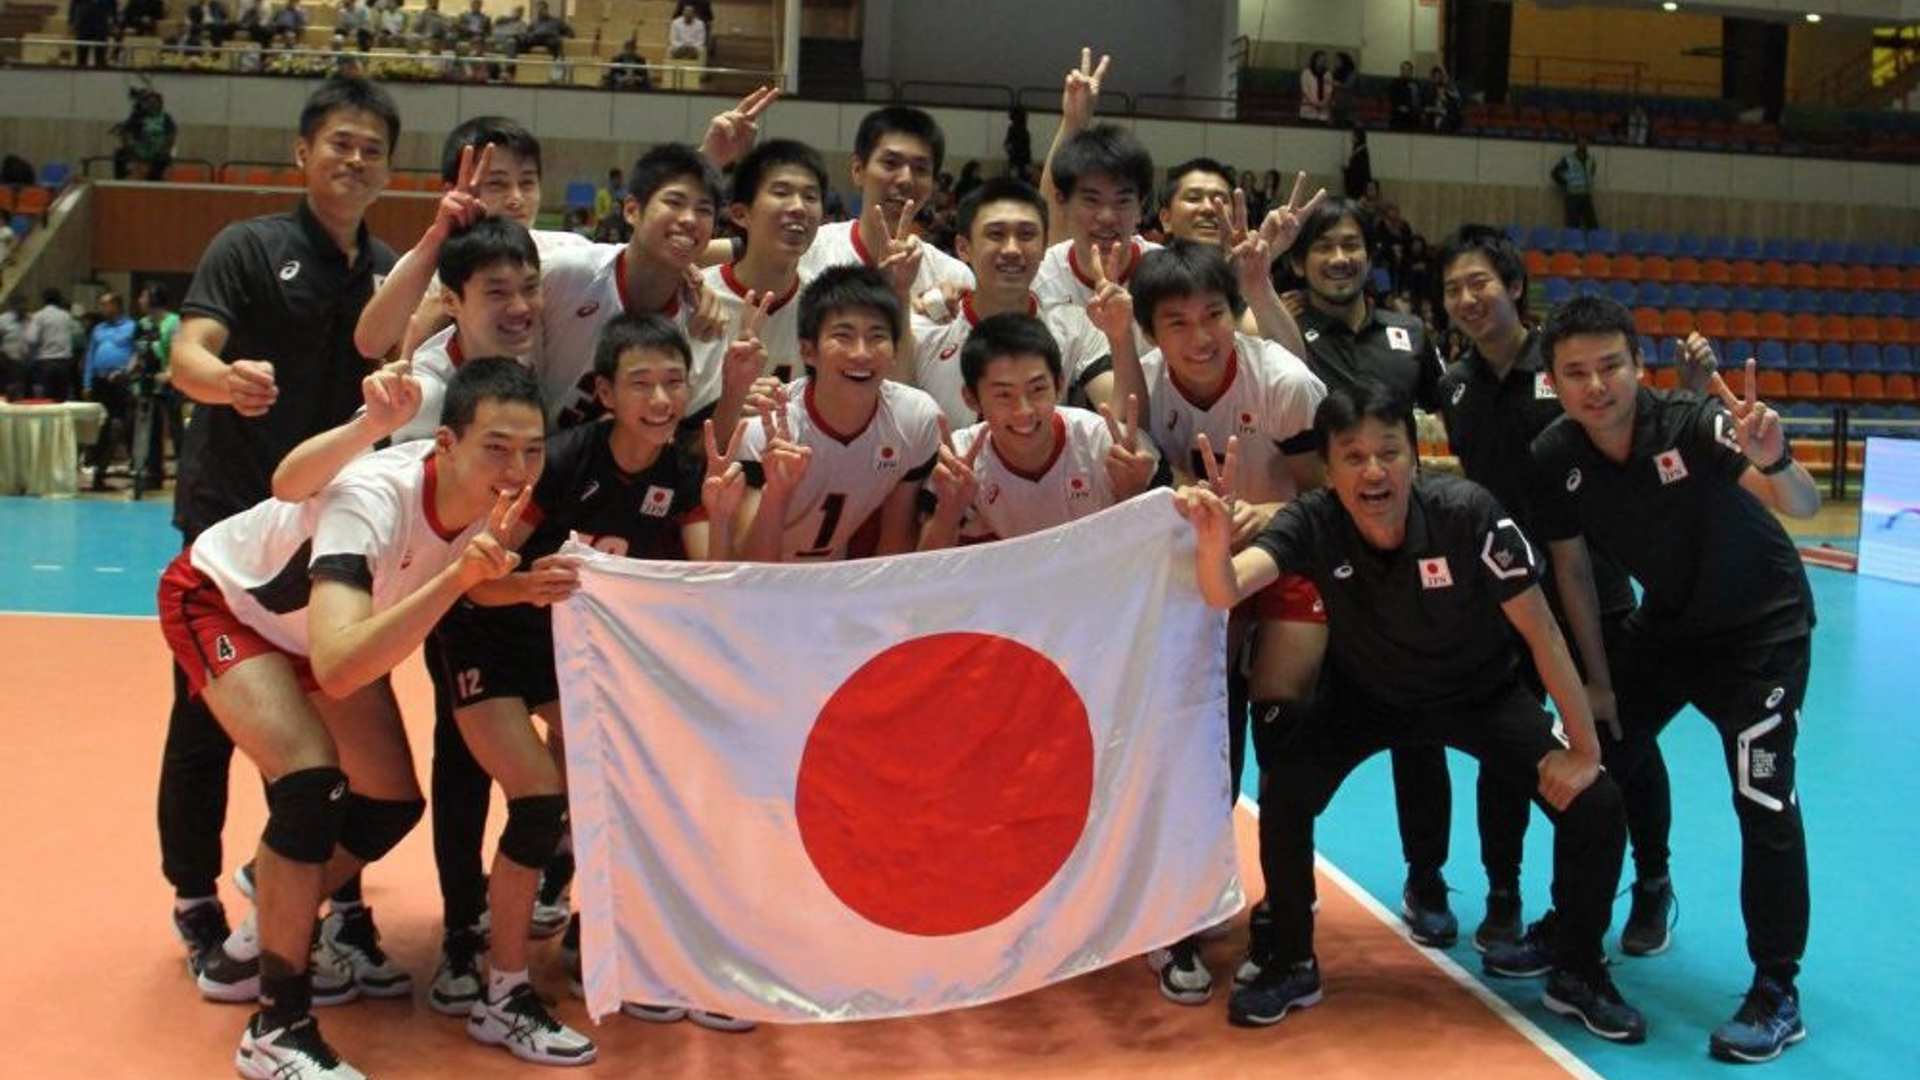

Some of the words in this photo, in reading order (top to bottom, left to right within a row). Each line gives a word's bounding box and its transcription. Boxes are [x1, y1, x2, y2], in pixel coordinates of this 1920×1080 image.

[795, 492, 847, 557] 1
[217, 634, 236, 662] 4
[457, 668, 484, 699] 12
